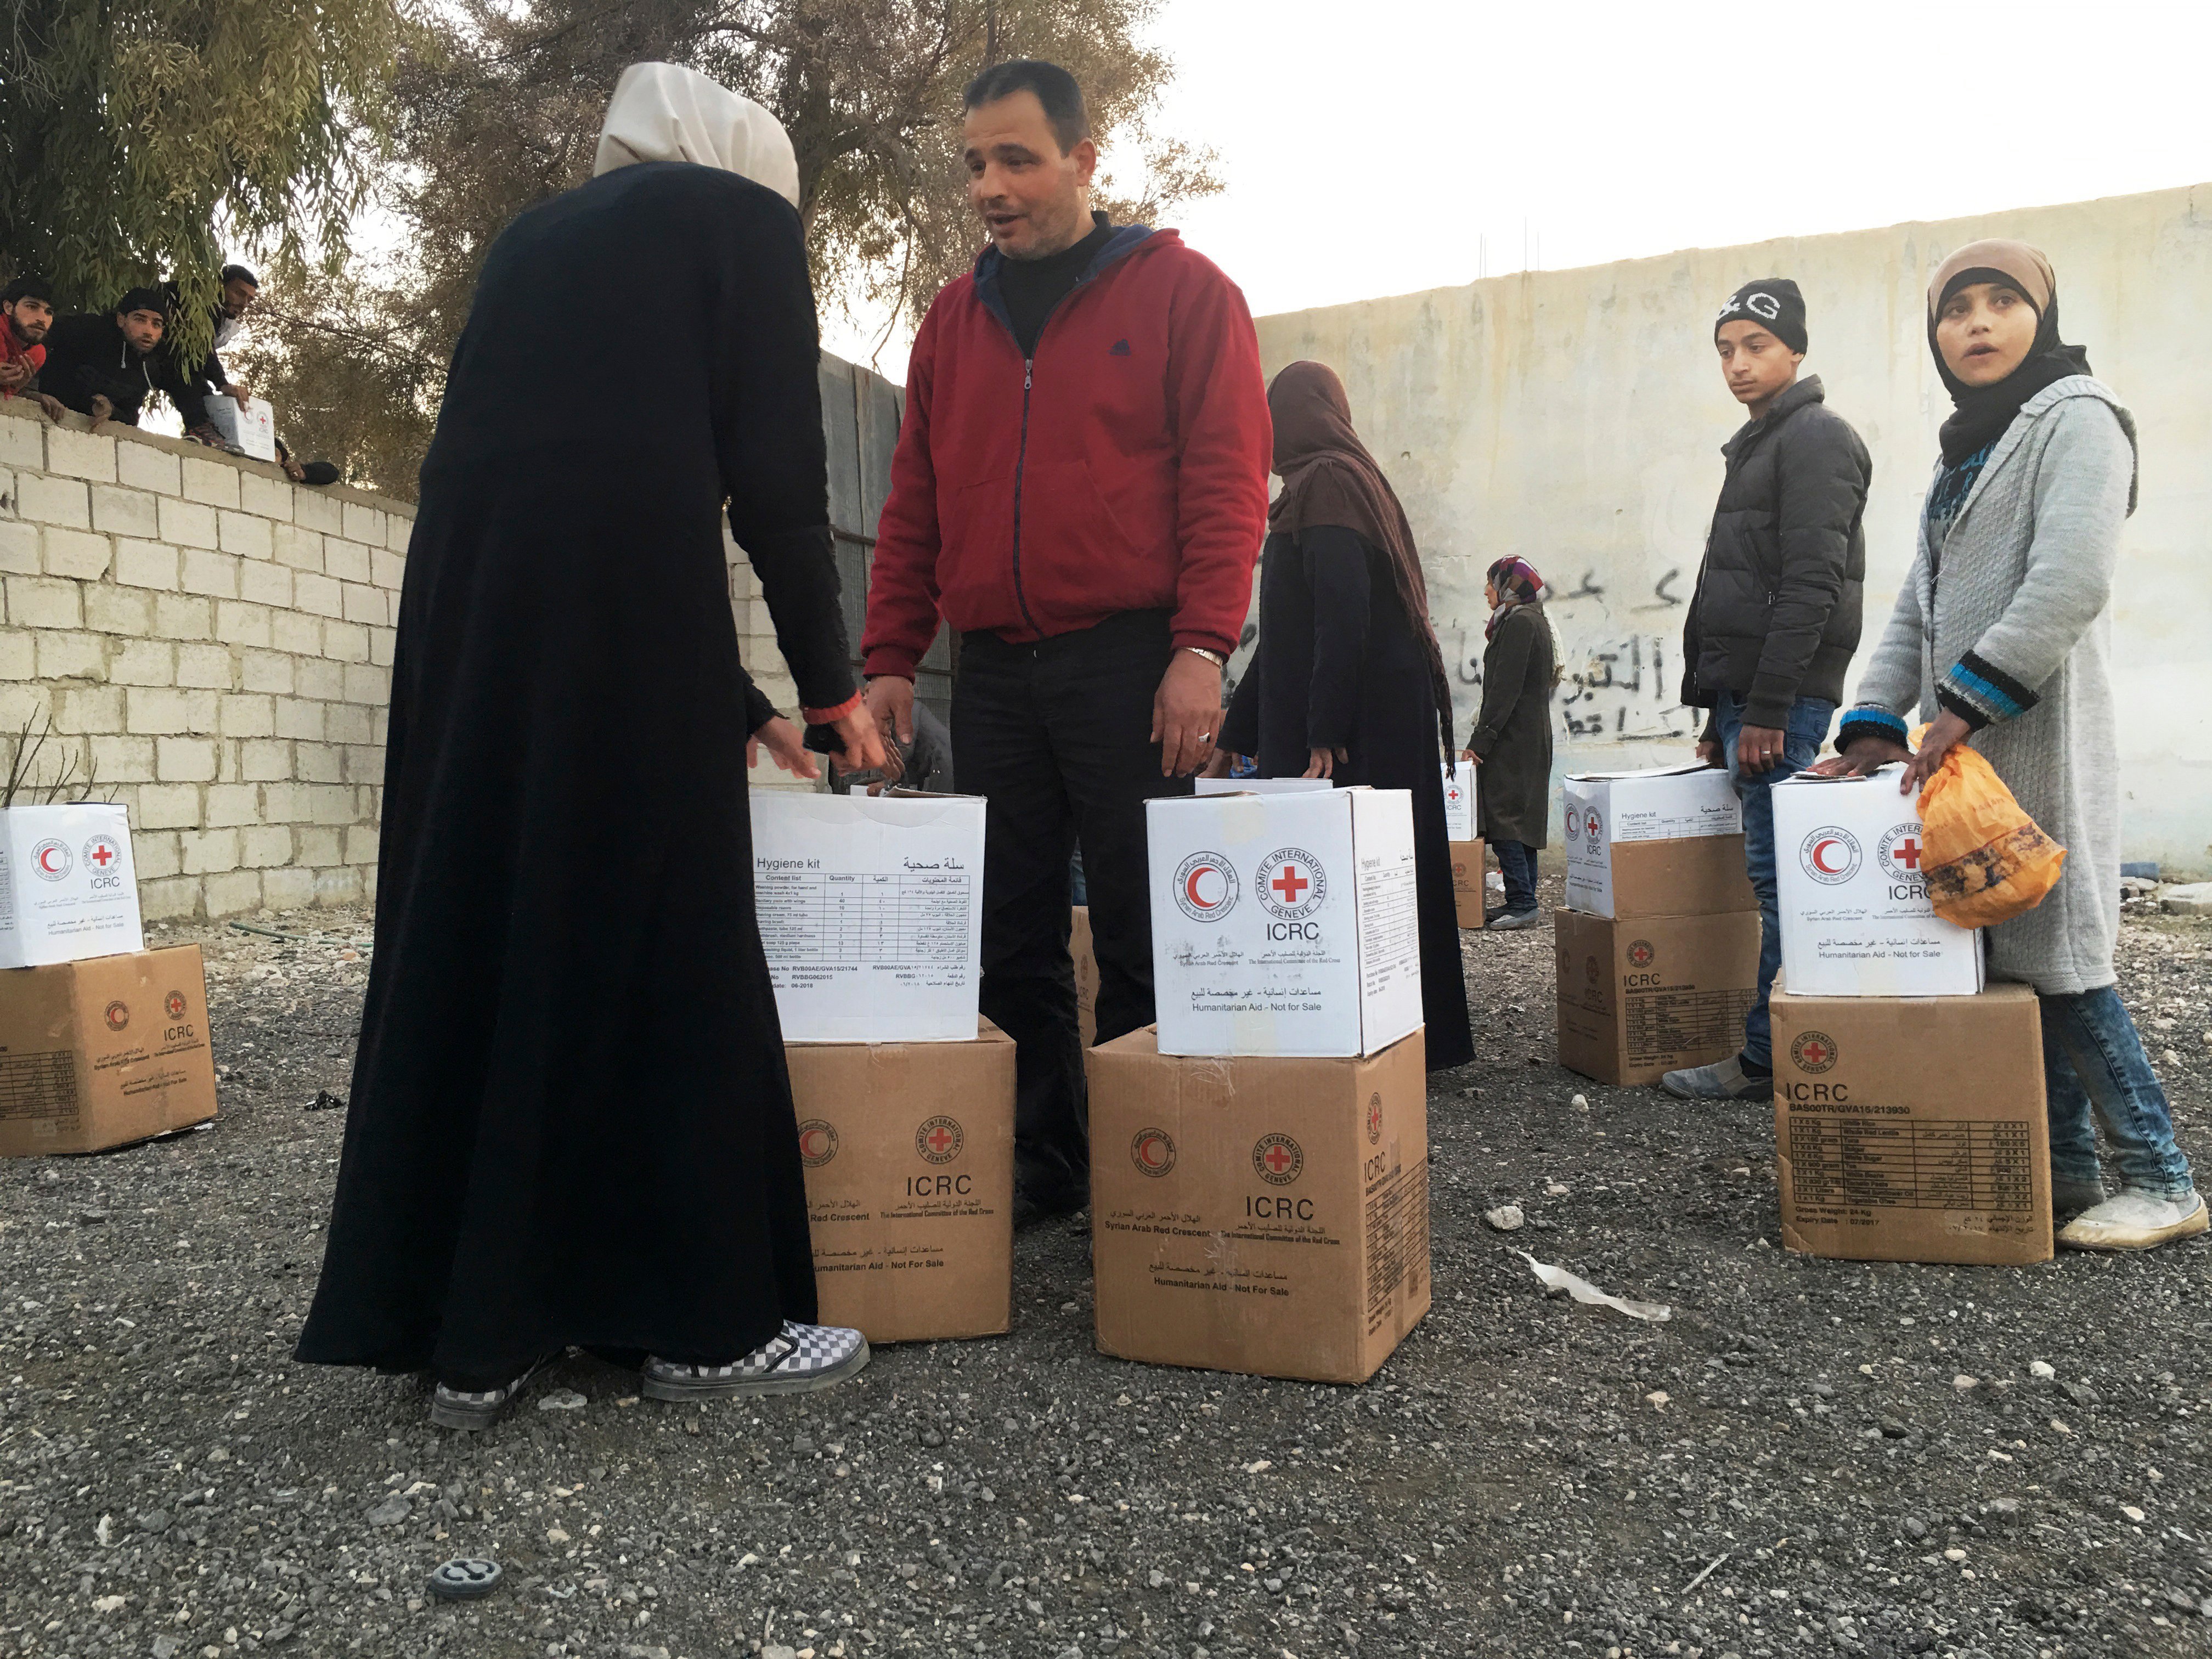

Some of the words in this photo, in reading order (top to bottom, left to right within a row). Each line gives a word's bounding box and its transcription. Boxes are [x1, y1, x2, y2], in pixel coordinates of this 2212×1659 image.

[1586, 844, 1601, 856] ICRC
[1880, 833, 1893, 867] COMITE
[757, 857, 804, 871] Hygiene
[808, 859, 820, 868] kit
[903, 856, 940, 872] صحية
[944, 857, 964, 870] سلة
[90, 876, 120, 889] ICRC
[873, 875, 888, 883] الكمية
[1257, 861, 1272, 901] COMITE
[1272, 850, 1324, 900] INTERNATIONAL
[1271, 904, 1313, 918] GENEVE
[1267, 922, 1319, 941] ICRC
[1818, 938, 1831, 949] للبيع
[1865, 939, 1876, 948] غير
[1886, 938, 1908, 946] إنسانية
[1623, 973, 1661, 987] ICRC
[1190, 986, 1206, 1000] للبيع
[1240, 987, 1252, 998] غير
[1263, 987, 1287, 998] إنسانية
[1289, 988, 1322, 997] مساعدات
[1192, 1002, 1248, 1012] Humanitarian
[1249, 1002, 1262, 1012] Aid
[1270, 1002, 1286, 1012] Not
[1287, 1002, 1299, 1011] for
[1301, 1002, 1322, 1011] Sale
[164, 1024, 194, 1041] ICRC
[1786, 1082, 1848, 1102] ICRC
[918, 1126, 927, 1154] COMITE
[926, 1118, 962, 1152] INTERNATIONAL
[926, 1152, 953, 1163] GENEVE
[1254, 1143, 1266, 1173] COMITE
[1263, 1135, 1301, 1173] INTERNATIONAL
[1364, 1151, 1385, 1183] ICRC
[906, 1173, 972, 1197] ICRC
[1264, 1173, 1293, 1184] GENEVE
[1246, 1195, 1313, 1221] ICRC
[810, 1214, 828, 1222] Red
[830, 1213, 870, 1222] Crescent
[1796, 1216, 1819, 1224] Expiry
[1105, 1221, 1130, 1231] Syrian
[1132, 1224, 1151, 1233] Arab
[1154, 1226, 1170, 1234] Red
[1172, 1227, 1210, 1237] Crescent
[814, 1263, 866, 1273] umanitarian
[868, 1261, 883, 1271] Aid
[891, 1261, 907, 1269] Not
[909, 1260, 923, 1268] For
[926, 1259, 944, 1268] Sale
[1154, 1277, 1210, 1290] Humanitarian
[1212, 1282, 1227, 1291] Aid
[1234, 1284, 1250, 1293] Not
[1252, 1285, 1267, 1294] For
[1270, 1286, 1289, 1296] Sale
